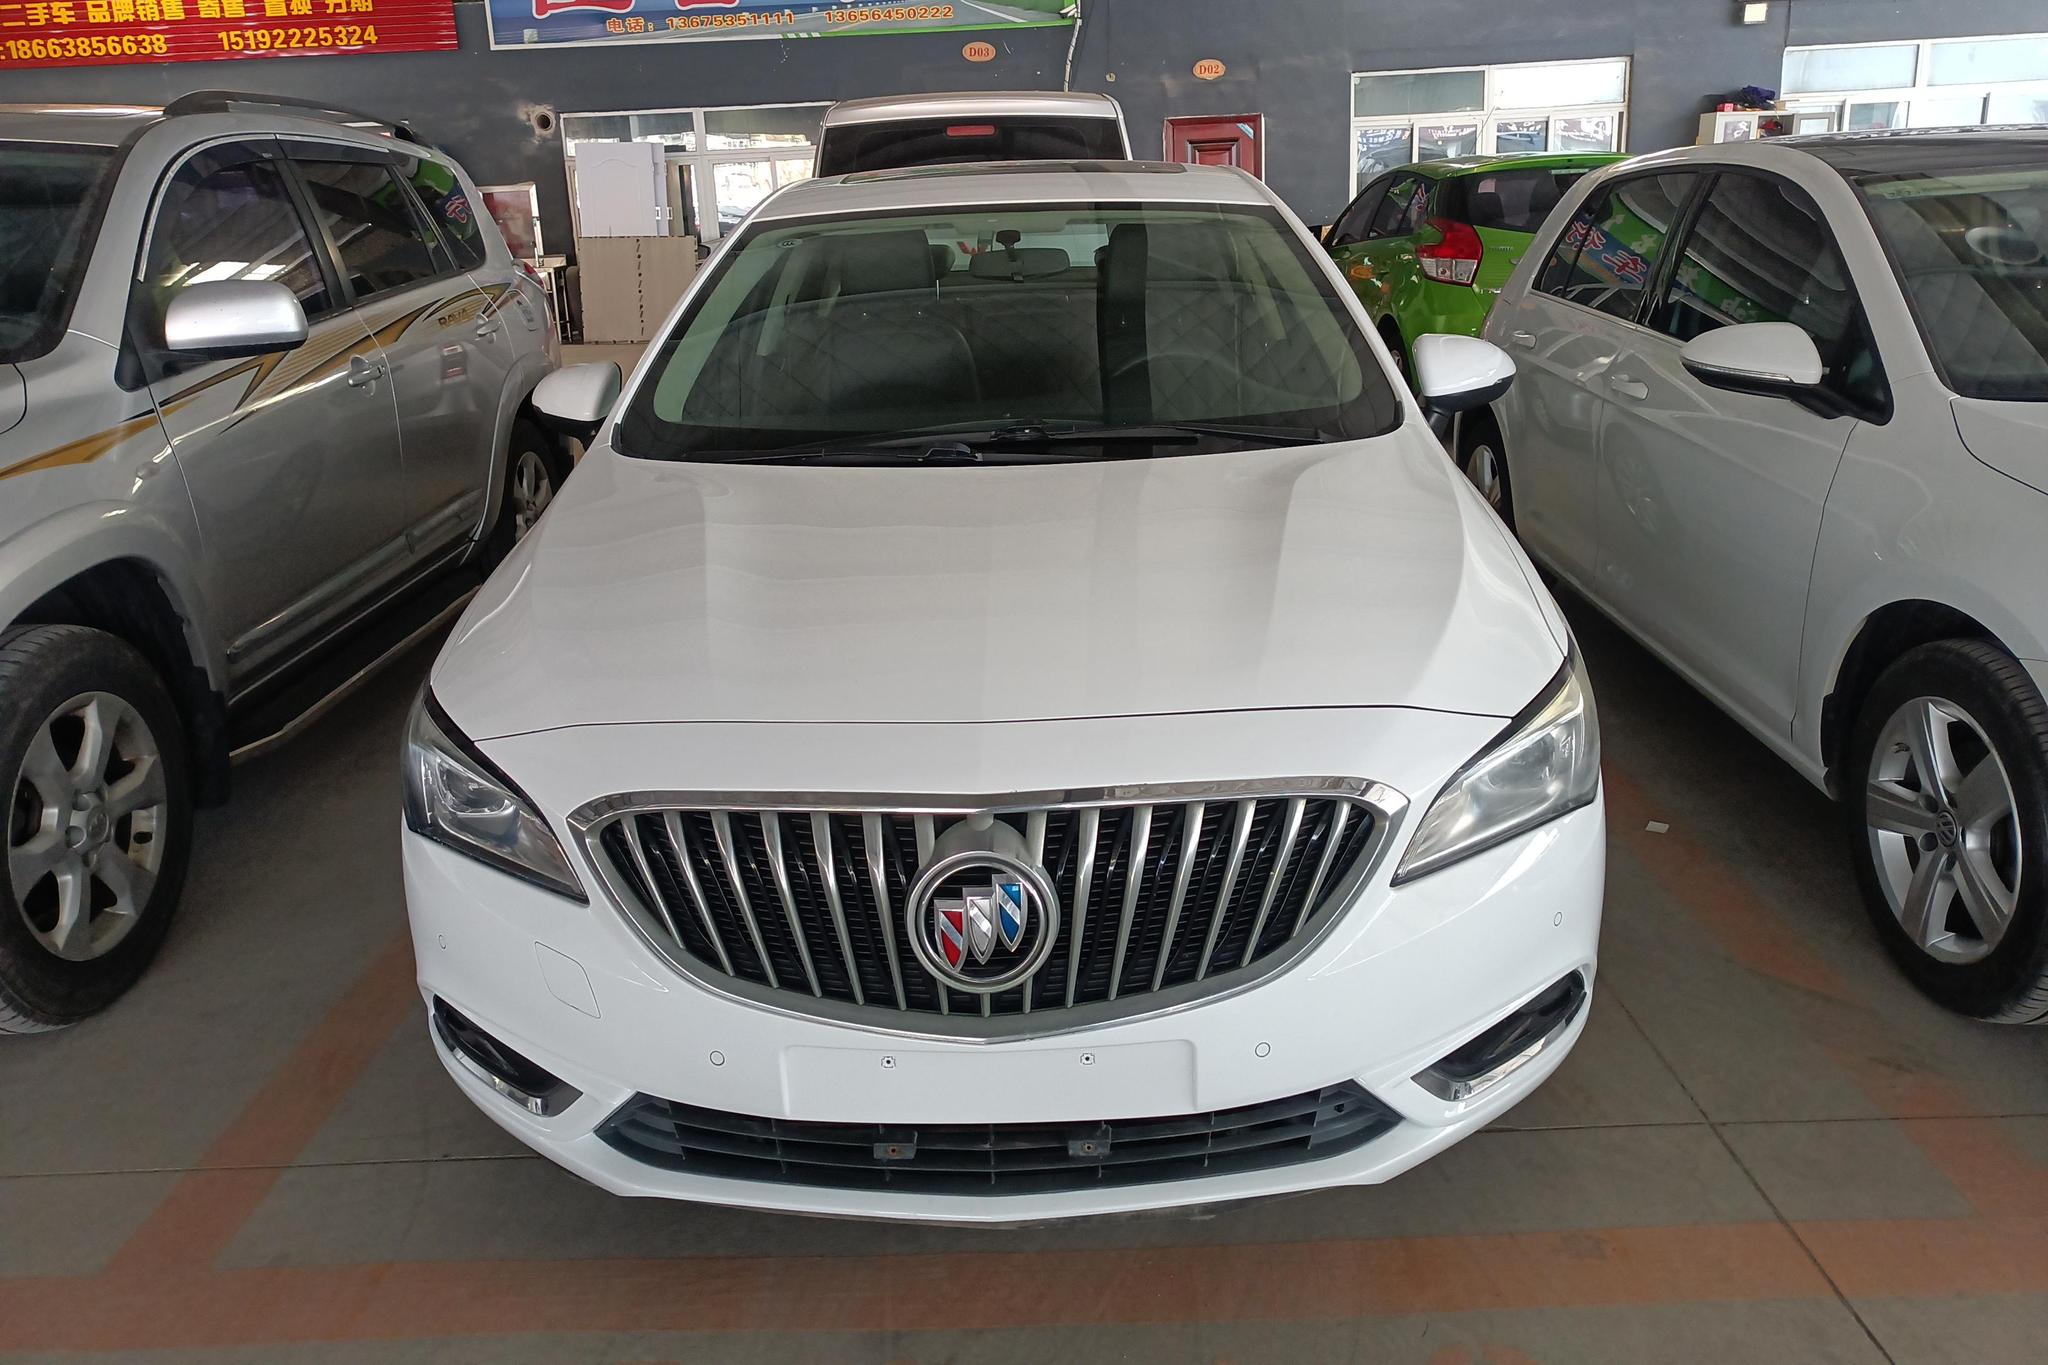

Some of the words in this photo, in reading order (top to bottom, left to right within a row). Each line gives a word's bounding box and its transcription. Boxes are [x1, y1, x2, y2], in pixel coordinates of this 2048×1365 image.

[0, 2, 76, 27] 二手车
[87, 0, 185, 23] 品牌销售
[666, 12, 795, 30] 13675351111
[823, 5, 954, 24] 13656450222
[217, 25, 378, 51] 15192225324
[969, 47, 990, 57] D03
[1199, 65, 1220, 75] D02
